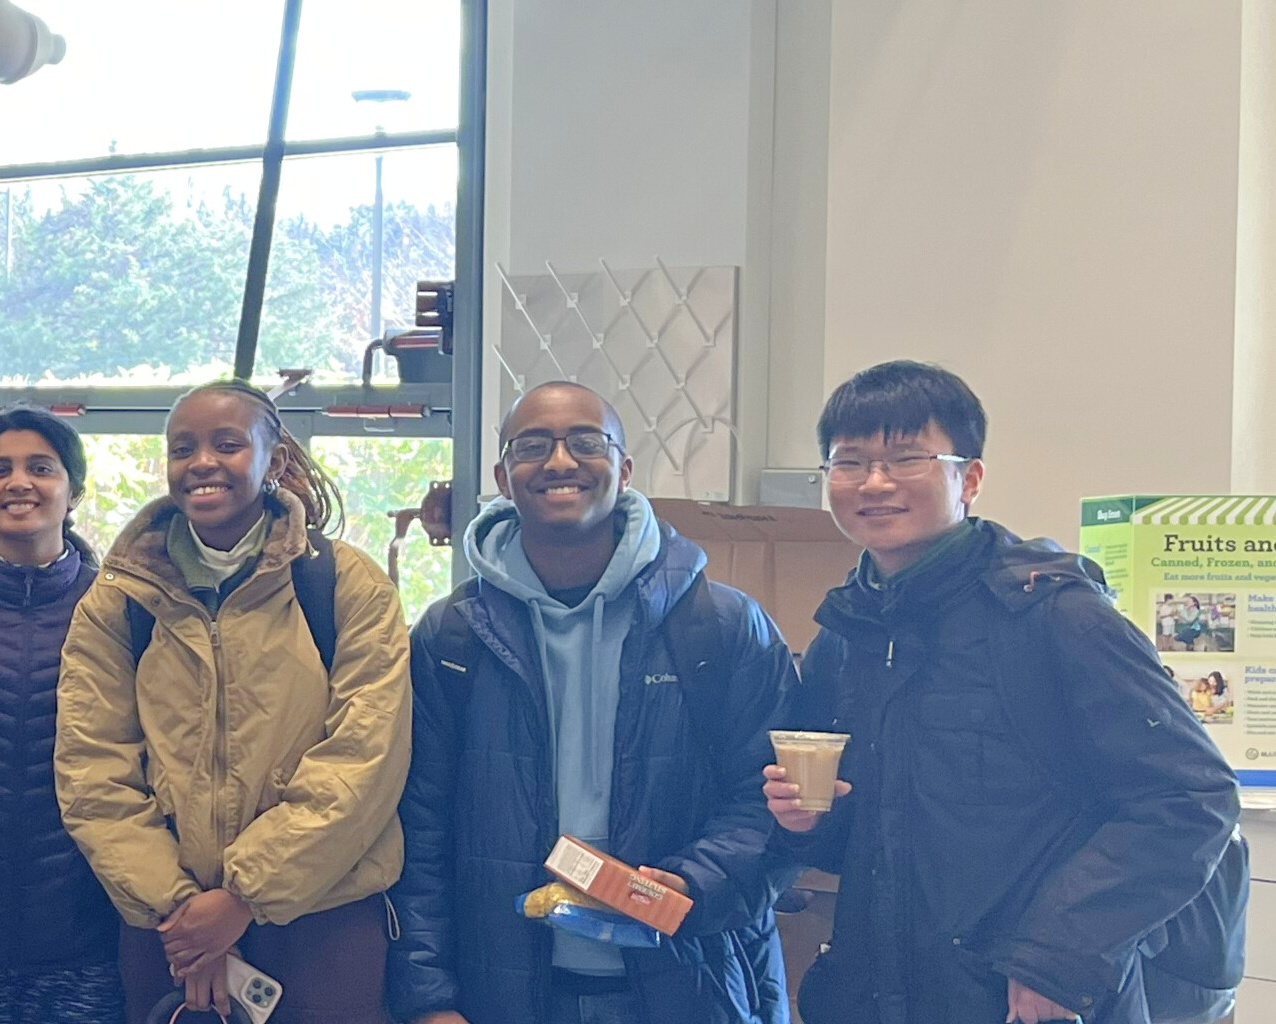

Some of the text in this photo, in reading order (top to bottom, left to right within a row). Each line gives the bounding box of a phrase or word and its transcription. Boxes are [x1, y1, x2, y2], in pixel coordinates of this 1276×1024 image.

[1164, 534, 1237, 552] Fruits
[1151, 556, 1203, 568] Canned,
[1207, 557, 1254, 568] Frozen,
[1164, 573, 1179, 581] Eat
[1235, 572, 1252, 581] and
